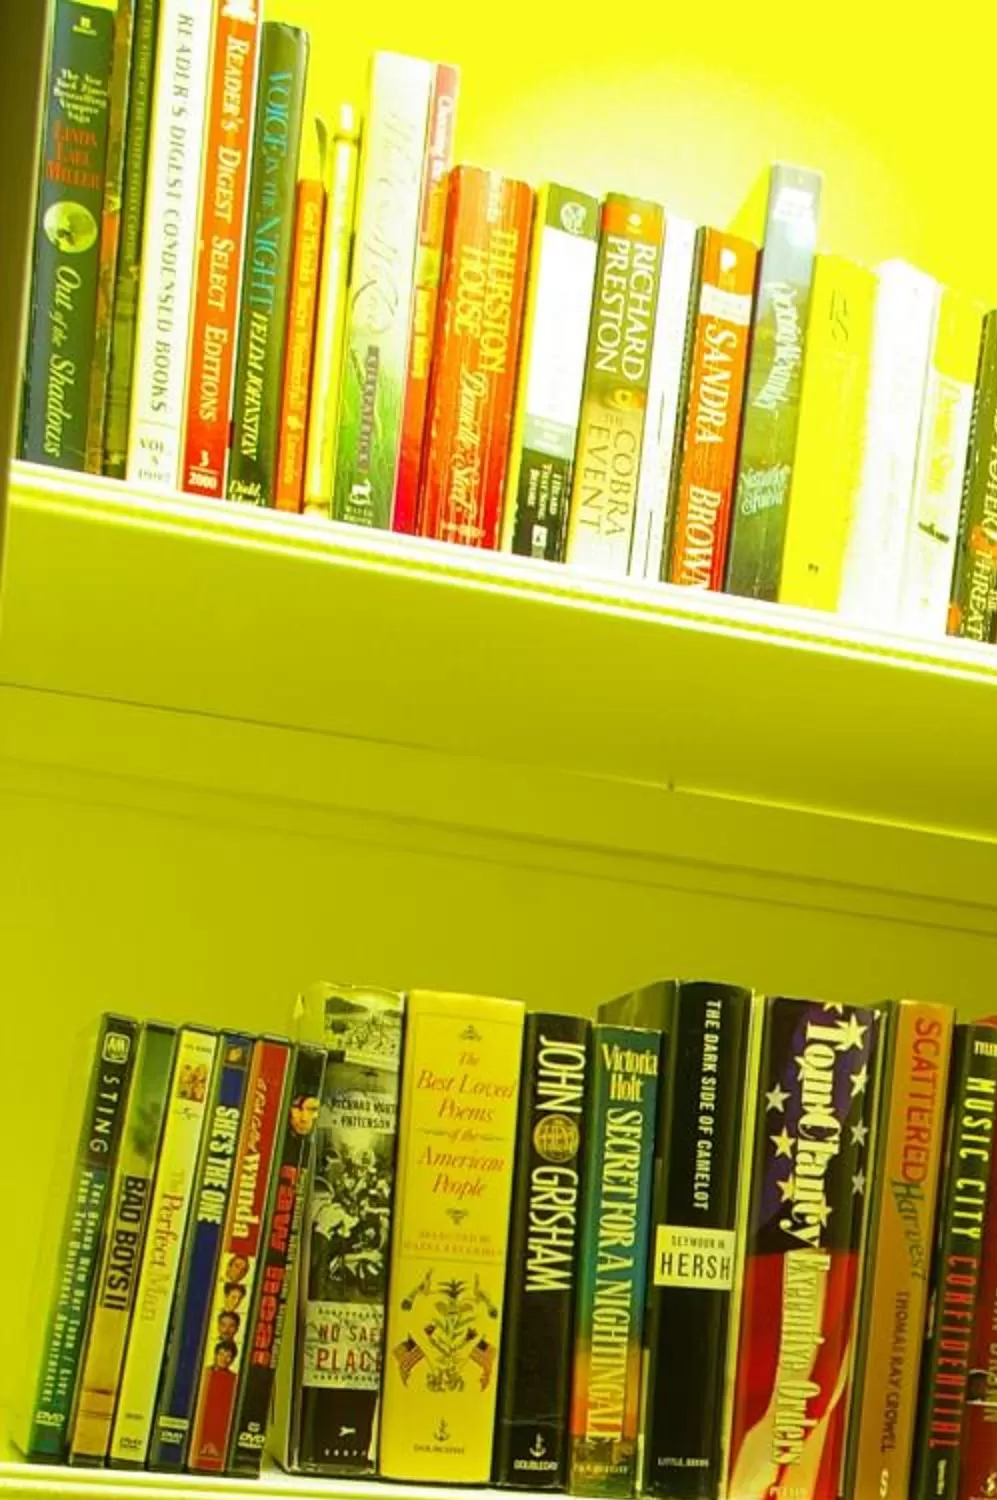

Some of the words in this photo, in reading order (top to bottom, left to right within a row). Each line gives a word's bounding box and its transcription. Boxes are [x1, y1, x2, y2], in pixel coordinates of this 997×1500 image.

[263, 71, 292, 154] VOICE
[165, 125, 187, 198] DIGEST
[214, 145, 242, 223] DIGEST
[51, 265, 81, 311] Out
[207, 235, 235, 311] SELECT
[250, 215, 281, 313] NIGHT
[452, 244, 490, 338] HOUSE
[480, 227, 518, 373] THURSTON
[594, 236, 628, 374] PRESTON
[622, 242, 657, 381] RICHARD
[43, 353, 77, 458] Shadows
[151, 339, 173, 412] BOOKS
[200, 324, 228, 422] EDITIONS
[695, 322, 738, 445] SANDRA
[577, 421, 611, 533] EVENT
[604, 426, 637, 537] COBRA
[963, 549, 993, 642] THREAT
[700, 1034, 720, 1073] DARK
[704, 1000, 722, 1030] THE
[416, 1070, 454, 1091] Best
[457, 1073, 515, 1100] Loved
[535, 1034, 587, 1114] JOHN
[601, 1043, 659, 1076] Victoria
[608, 1074, 643, 1103] Holt
[698, 1077, 717, 1113] SIDE
[794, 1020, 848, 1112] Tom
[88, 1074, 118, 1154] STING
[208, 1105, 240, 1154] SHE'S
[437, 1099, 496, 1123] Poems
[698, 1115, 715, 1136] OF
[900, 1017, 944, 1183] SCATTERED
[958, 1077, 997, 1158] MUSIC
[202, 1156, 235, 1187] THE
[416, 1145, 506, 1174] American
[431, 1173, 489, 1201] People
[601, 1106, 644, 1199] SECRET
[692, 1140, 713, 1211] CAMELOT
[779, 1113, 841, 1249] Clancy
[120, 1174, 147, 1227] BAD
[150, 1191, 182, 1268] Perfect
[196, 1189, 228, 1224] ONE
[231, 1152, 262, 1238] wanda
[524, 1165, 580, 1293] GRISHAM
[598, 1199, 638, 1248] FOR
[888, 1180, 928, 1282] Harvest
[949, 1178, 988, 1241] CITY
[107, 1230, 137, 1290] BOYS
[596, 1253, 634, 1273] A
[659, 1252, 731, 1280] HERSH
[317, 1325, 345, 1345] NO
[782, 1251, 832, 1371] Executive
[583, 1278, 632, 1444] NIGHTINGALE
[884, 1355, 905, 1389] RAY
[927, 1254, 978, 1449] CONFIDENTIAL
[771, 1379, 820, 1465] Orders
